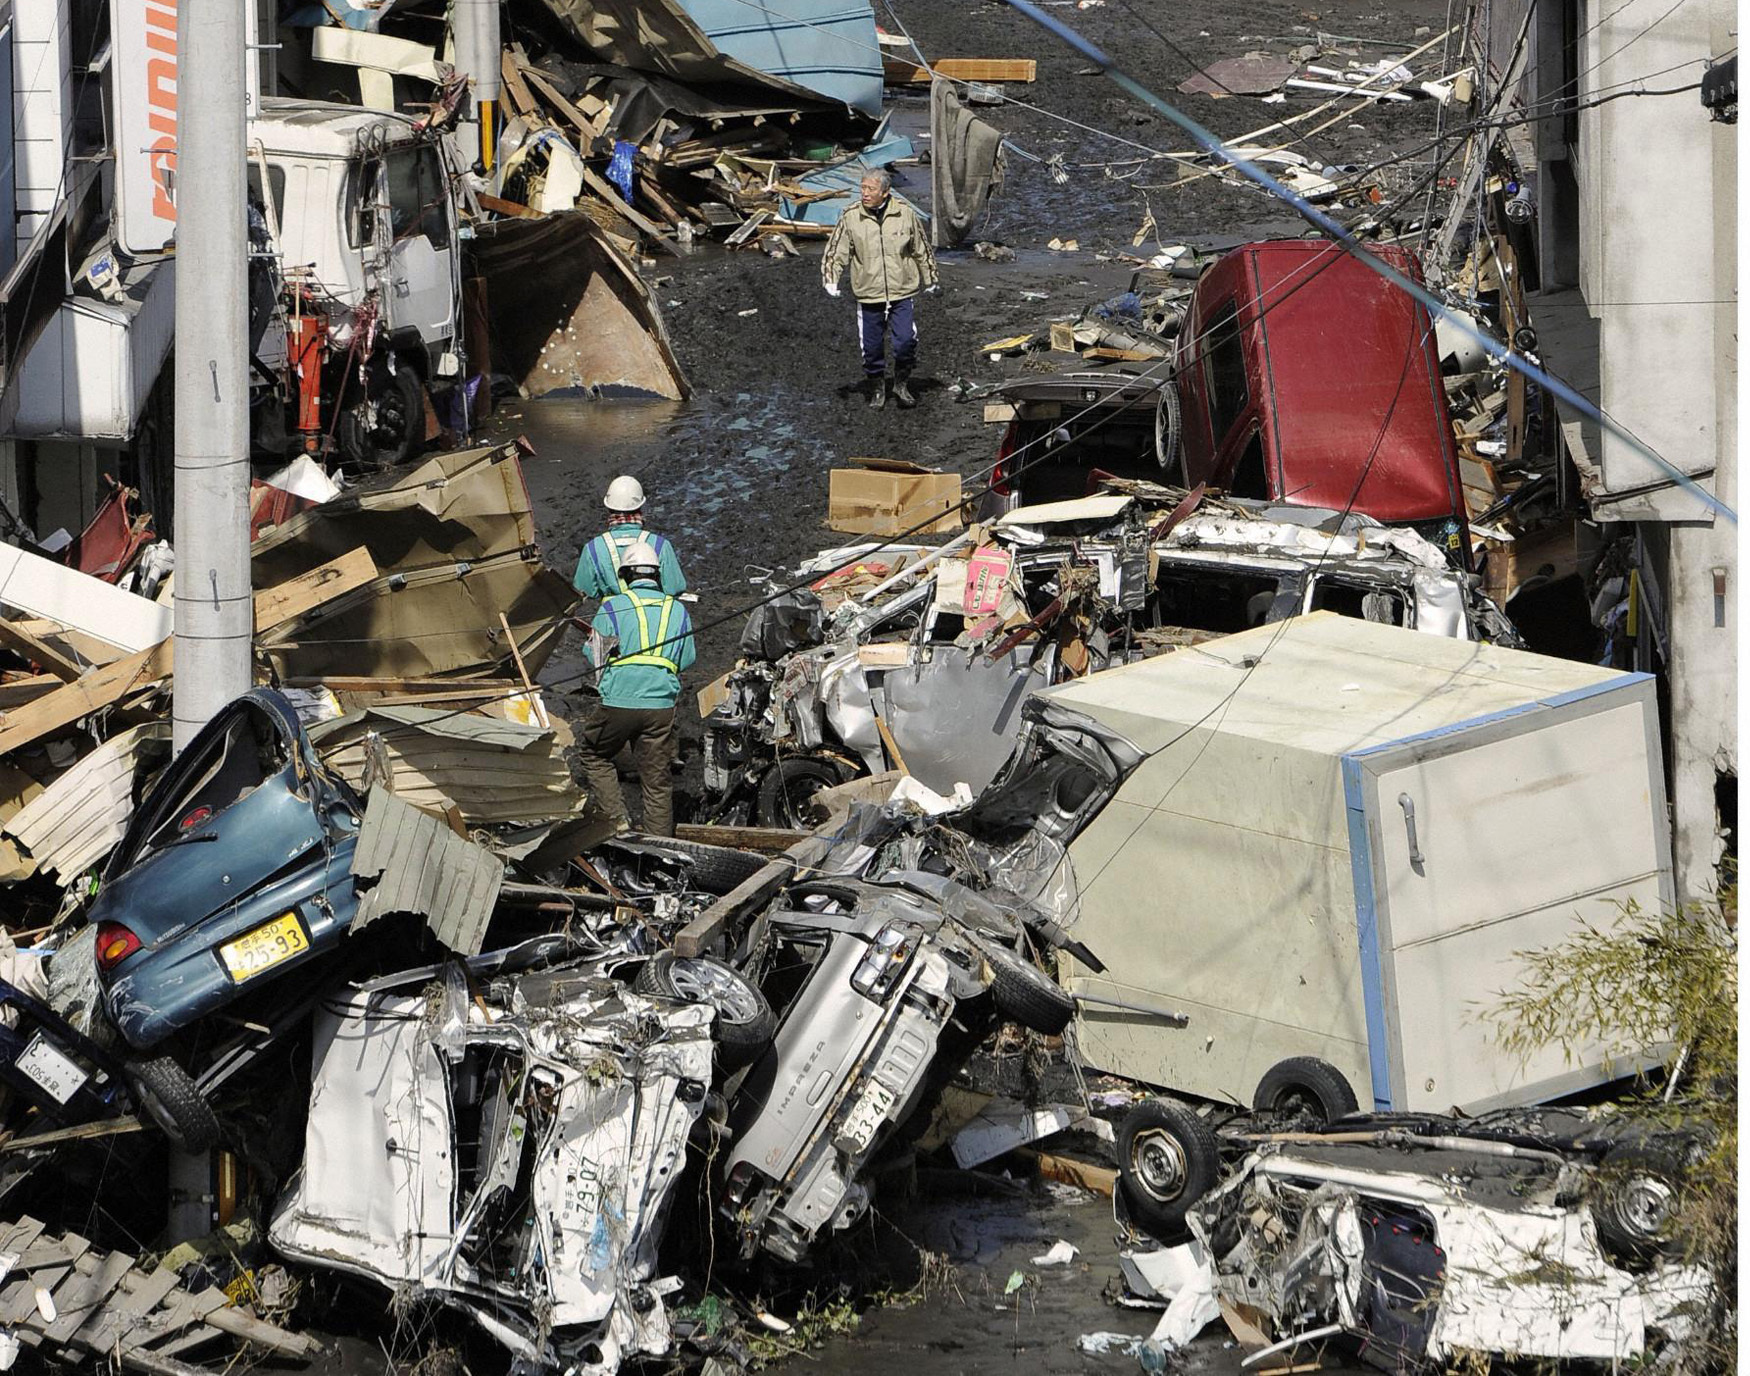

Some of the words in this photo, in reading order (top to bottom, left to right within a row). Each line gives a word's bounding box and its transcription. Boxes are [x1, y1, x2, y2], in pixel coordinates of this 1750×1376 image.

[244, 929, 301, 968] 25-93
[776, 1040, 826, 1115] IMPREZA
[853, 1091, 891, 1145] 33-44
[576, 1156, 599, 1214] 79-07
